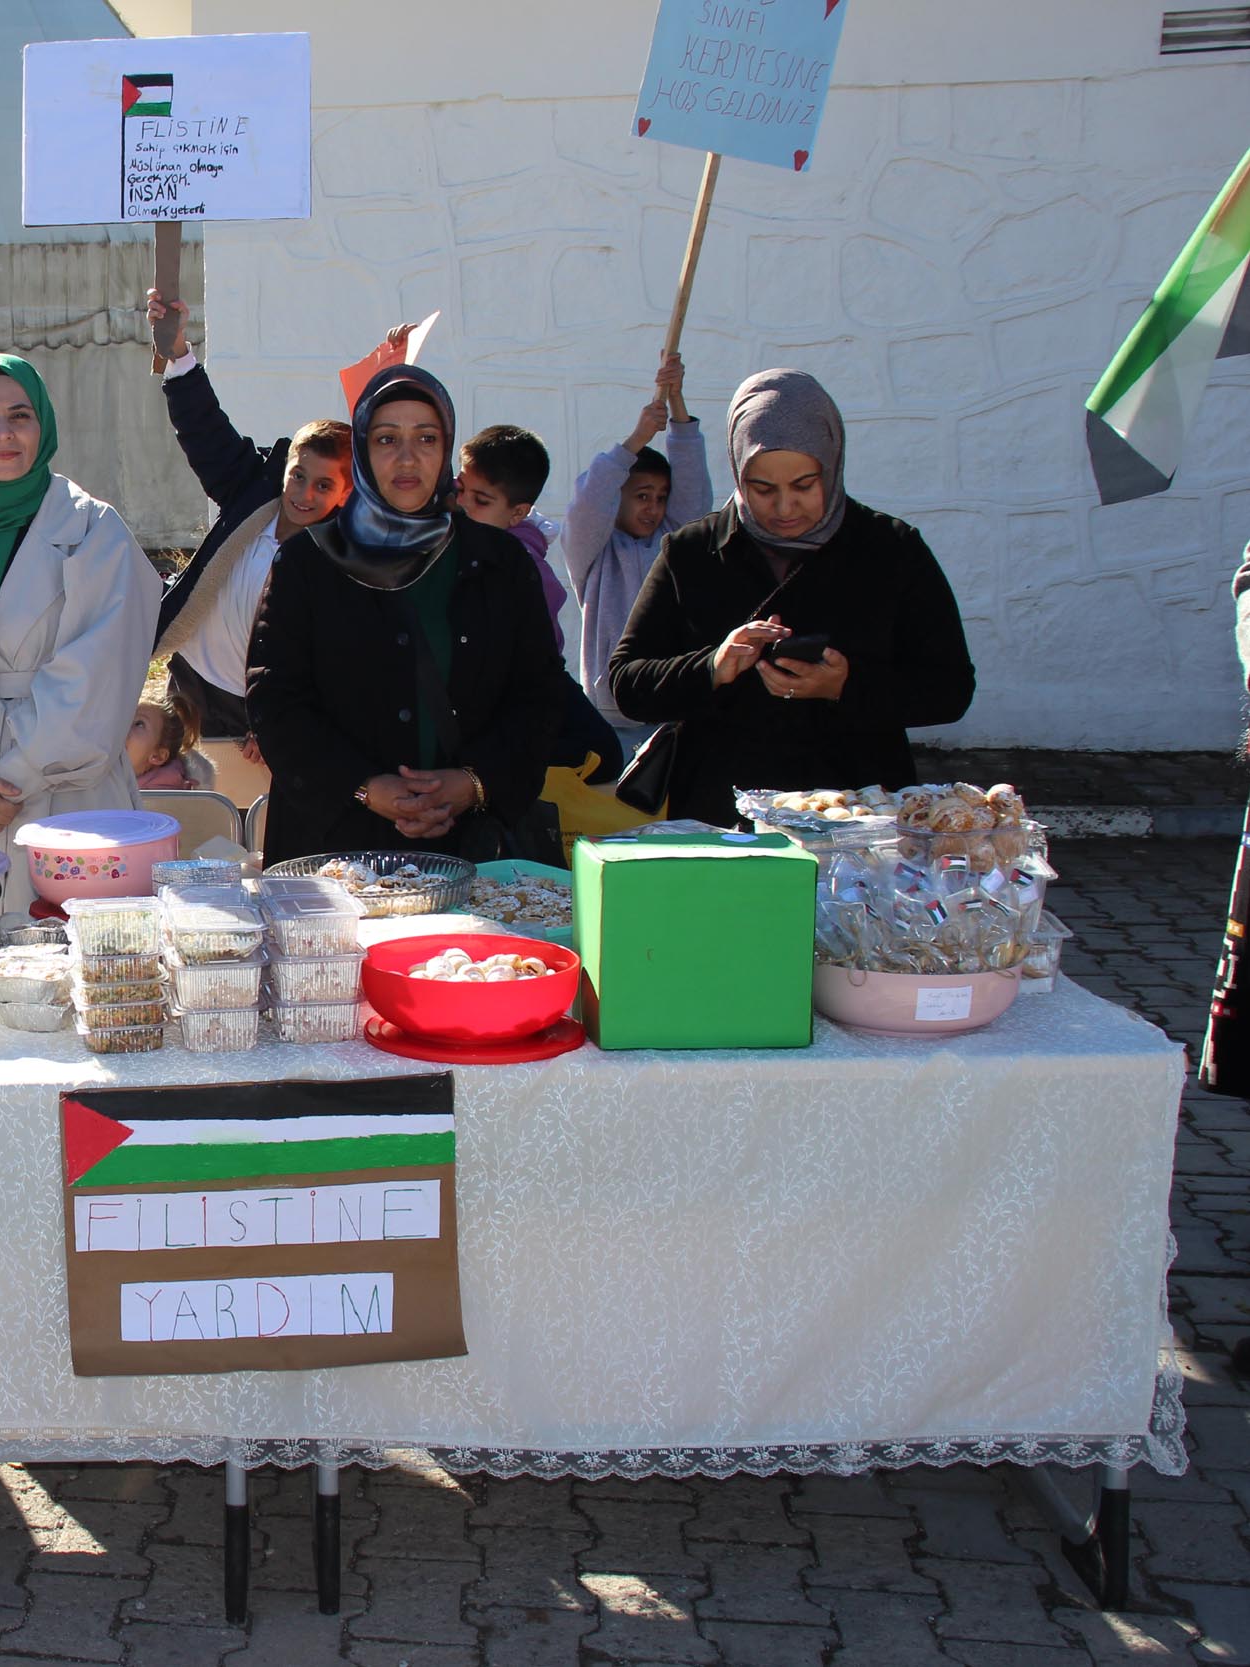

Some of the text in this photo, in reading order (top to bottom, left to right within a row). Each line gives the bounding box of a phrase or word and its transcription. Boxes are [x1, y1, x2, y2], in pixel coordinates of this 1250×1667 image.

[135, 142, 165, 159] Sahip
[219, 141, 239, 156] için
[134, 1281, 383, 1341] YARDIM
